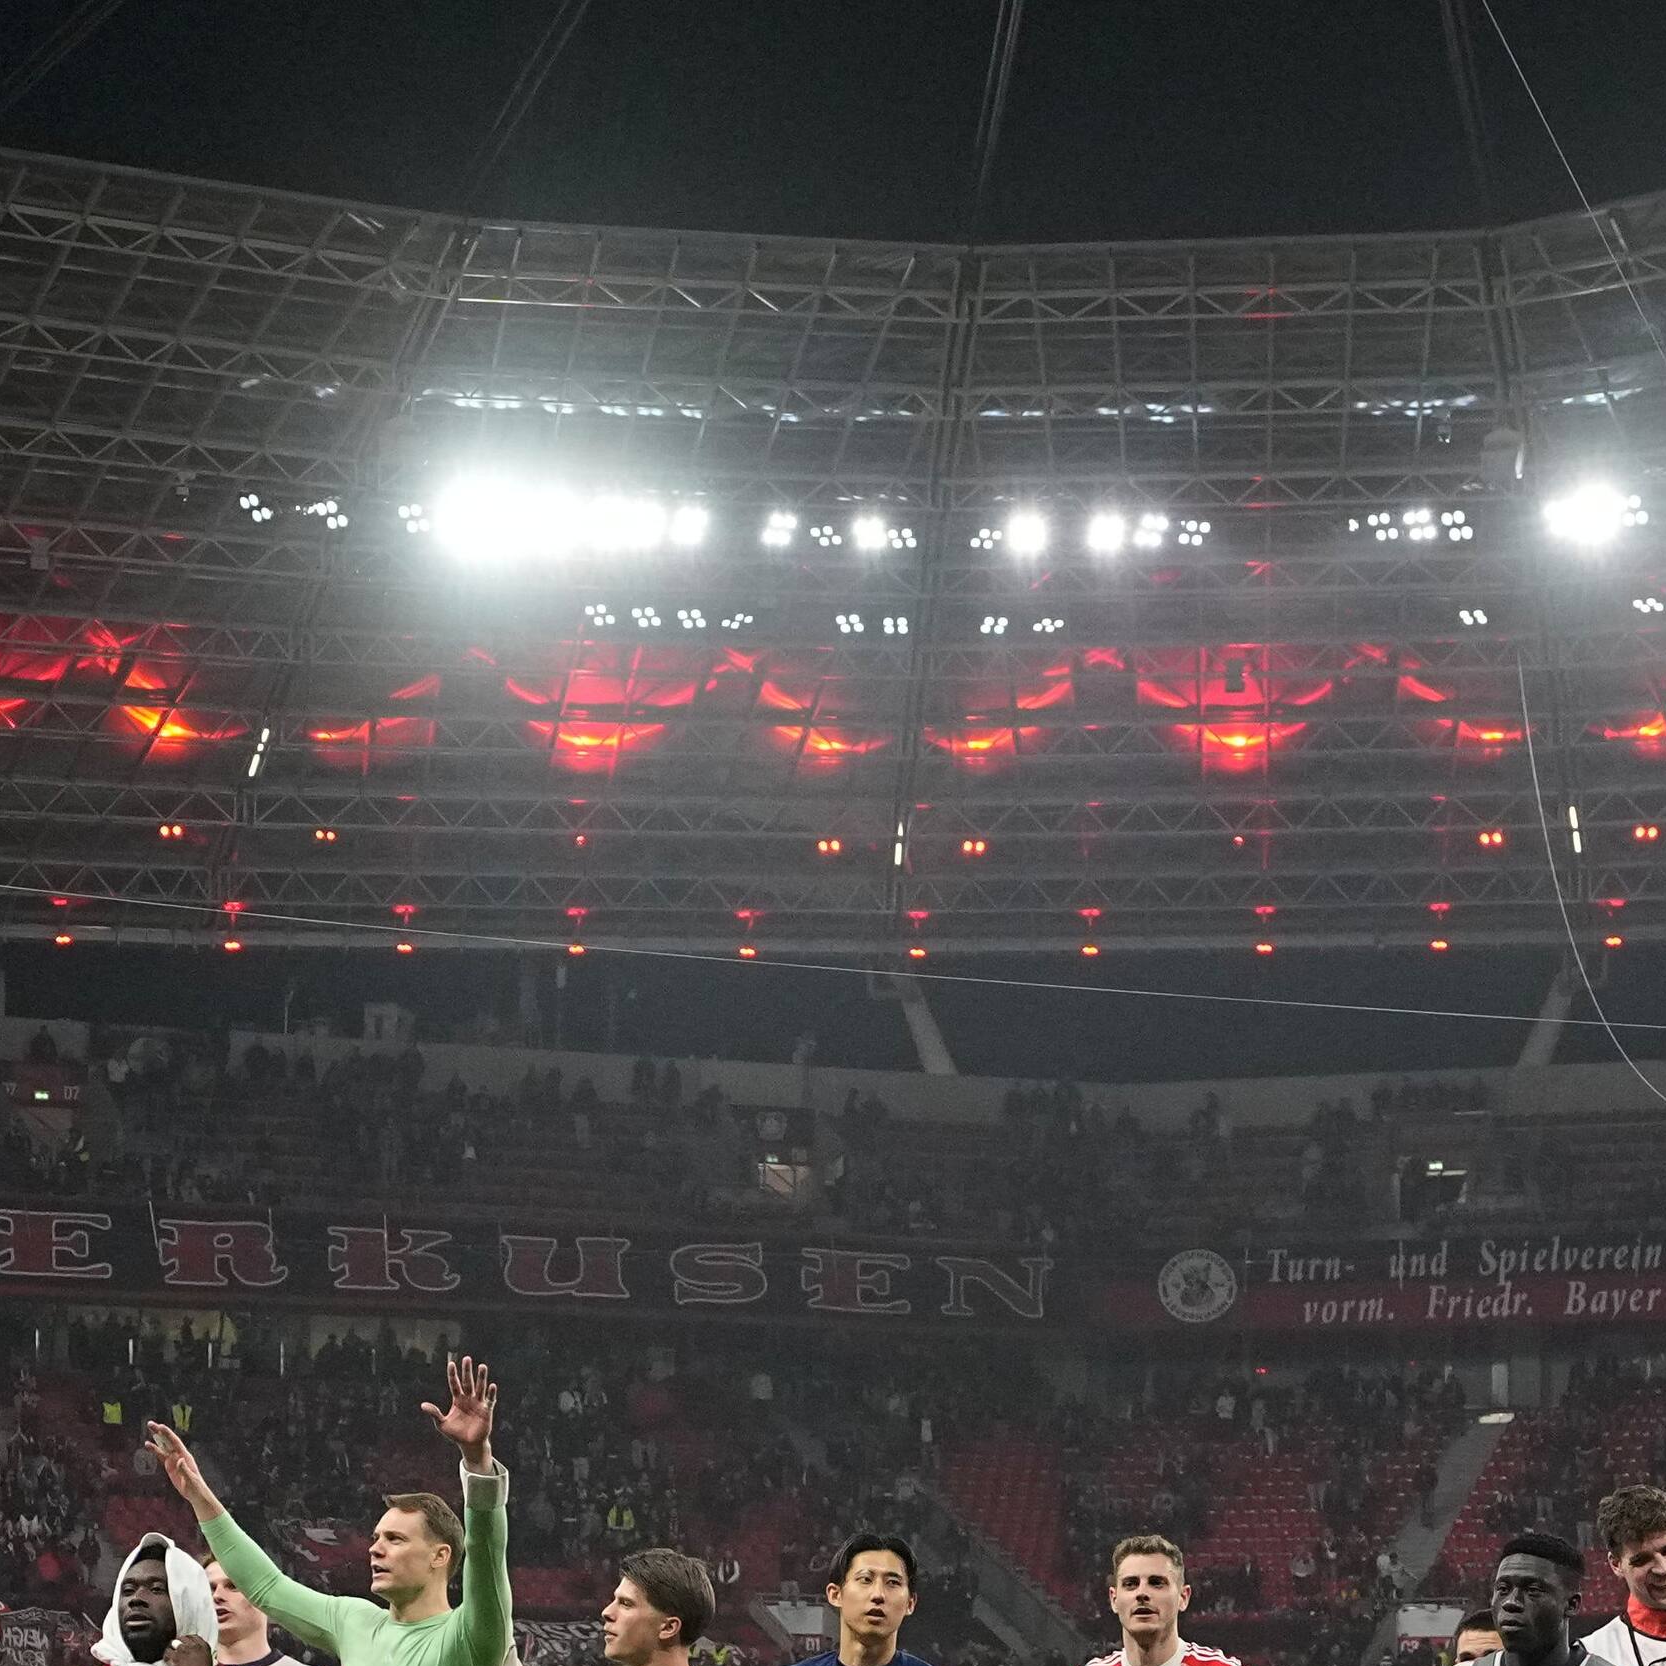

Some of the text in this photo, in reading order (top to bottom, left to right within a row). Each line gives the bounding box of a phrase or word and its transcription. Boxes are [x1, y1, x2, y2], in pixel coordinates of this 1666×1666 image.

[1267, 1248, 1355, 1284] Turn-
[1389, 1241, 1448, 1280] und
[1479, 1236, 1664, 1286] Spielverein
[1303, 1297, 1395, 1325] vorm.
[1425, 1284, 1533, 1321] Friedr.
[1565, 1281, 1662, 1320] Bayer
